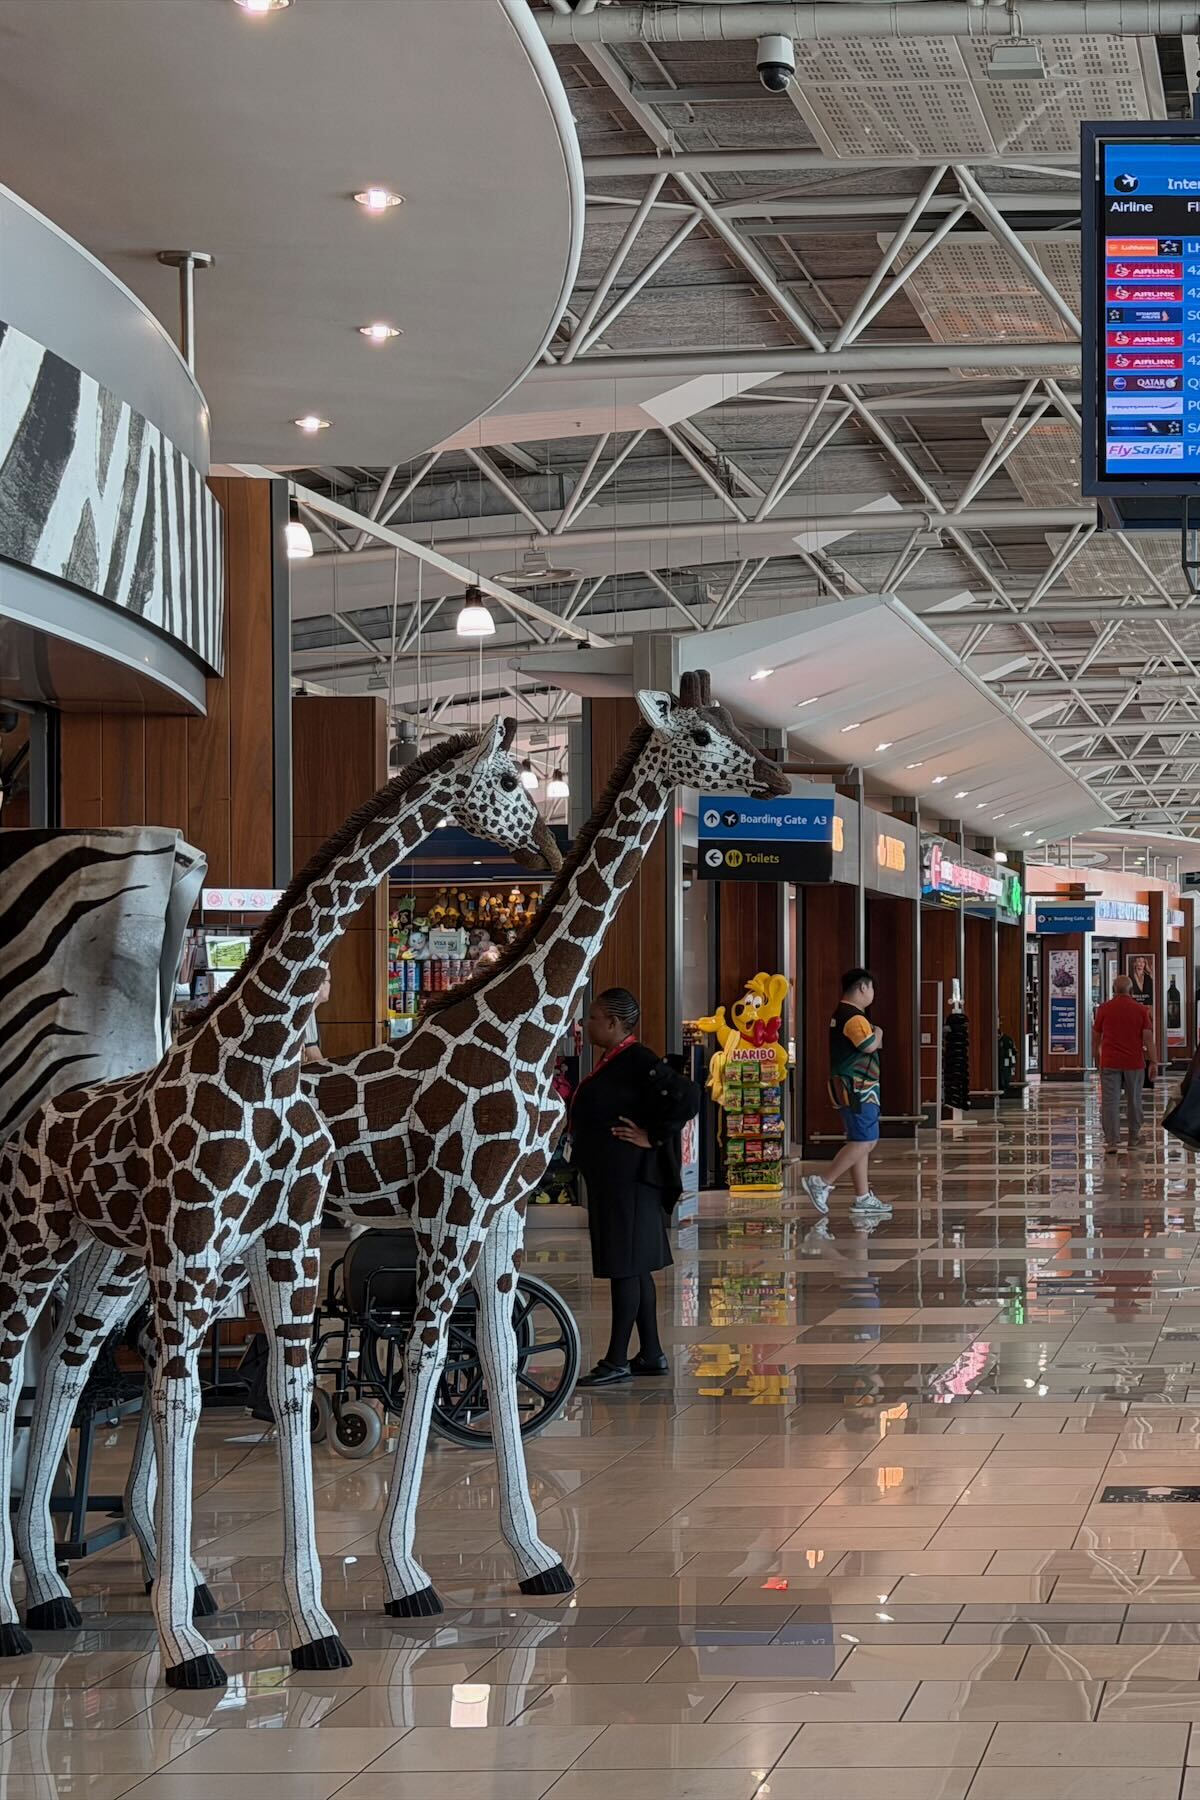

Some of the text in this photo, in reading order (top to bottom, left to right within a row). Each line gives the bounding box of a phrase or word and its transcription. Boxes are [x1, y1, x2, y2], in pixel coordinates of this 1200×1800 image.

[1110, 201, 1153, 212] Airline
[1137, 379, 1165, 387] QATAR
[1109, 445, 1177, 457] FlySafair
[740, 814, 827, 826] Boarding Gate A3
[745, 853, 780, 863] Toilets
[733, 1050, 775, 1060] HARIBO
